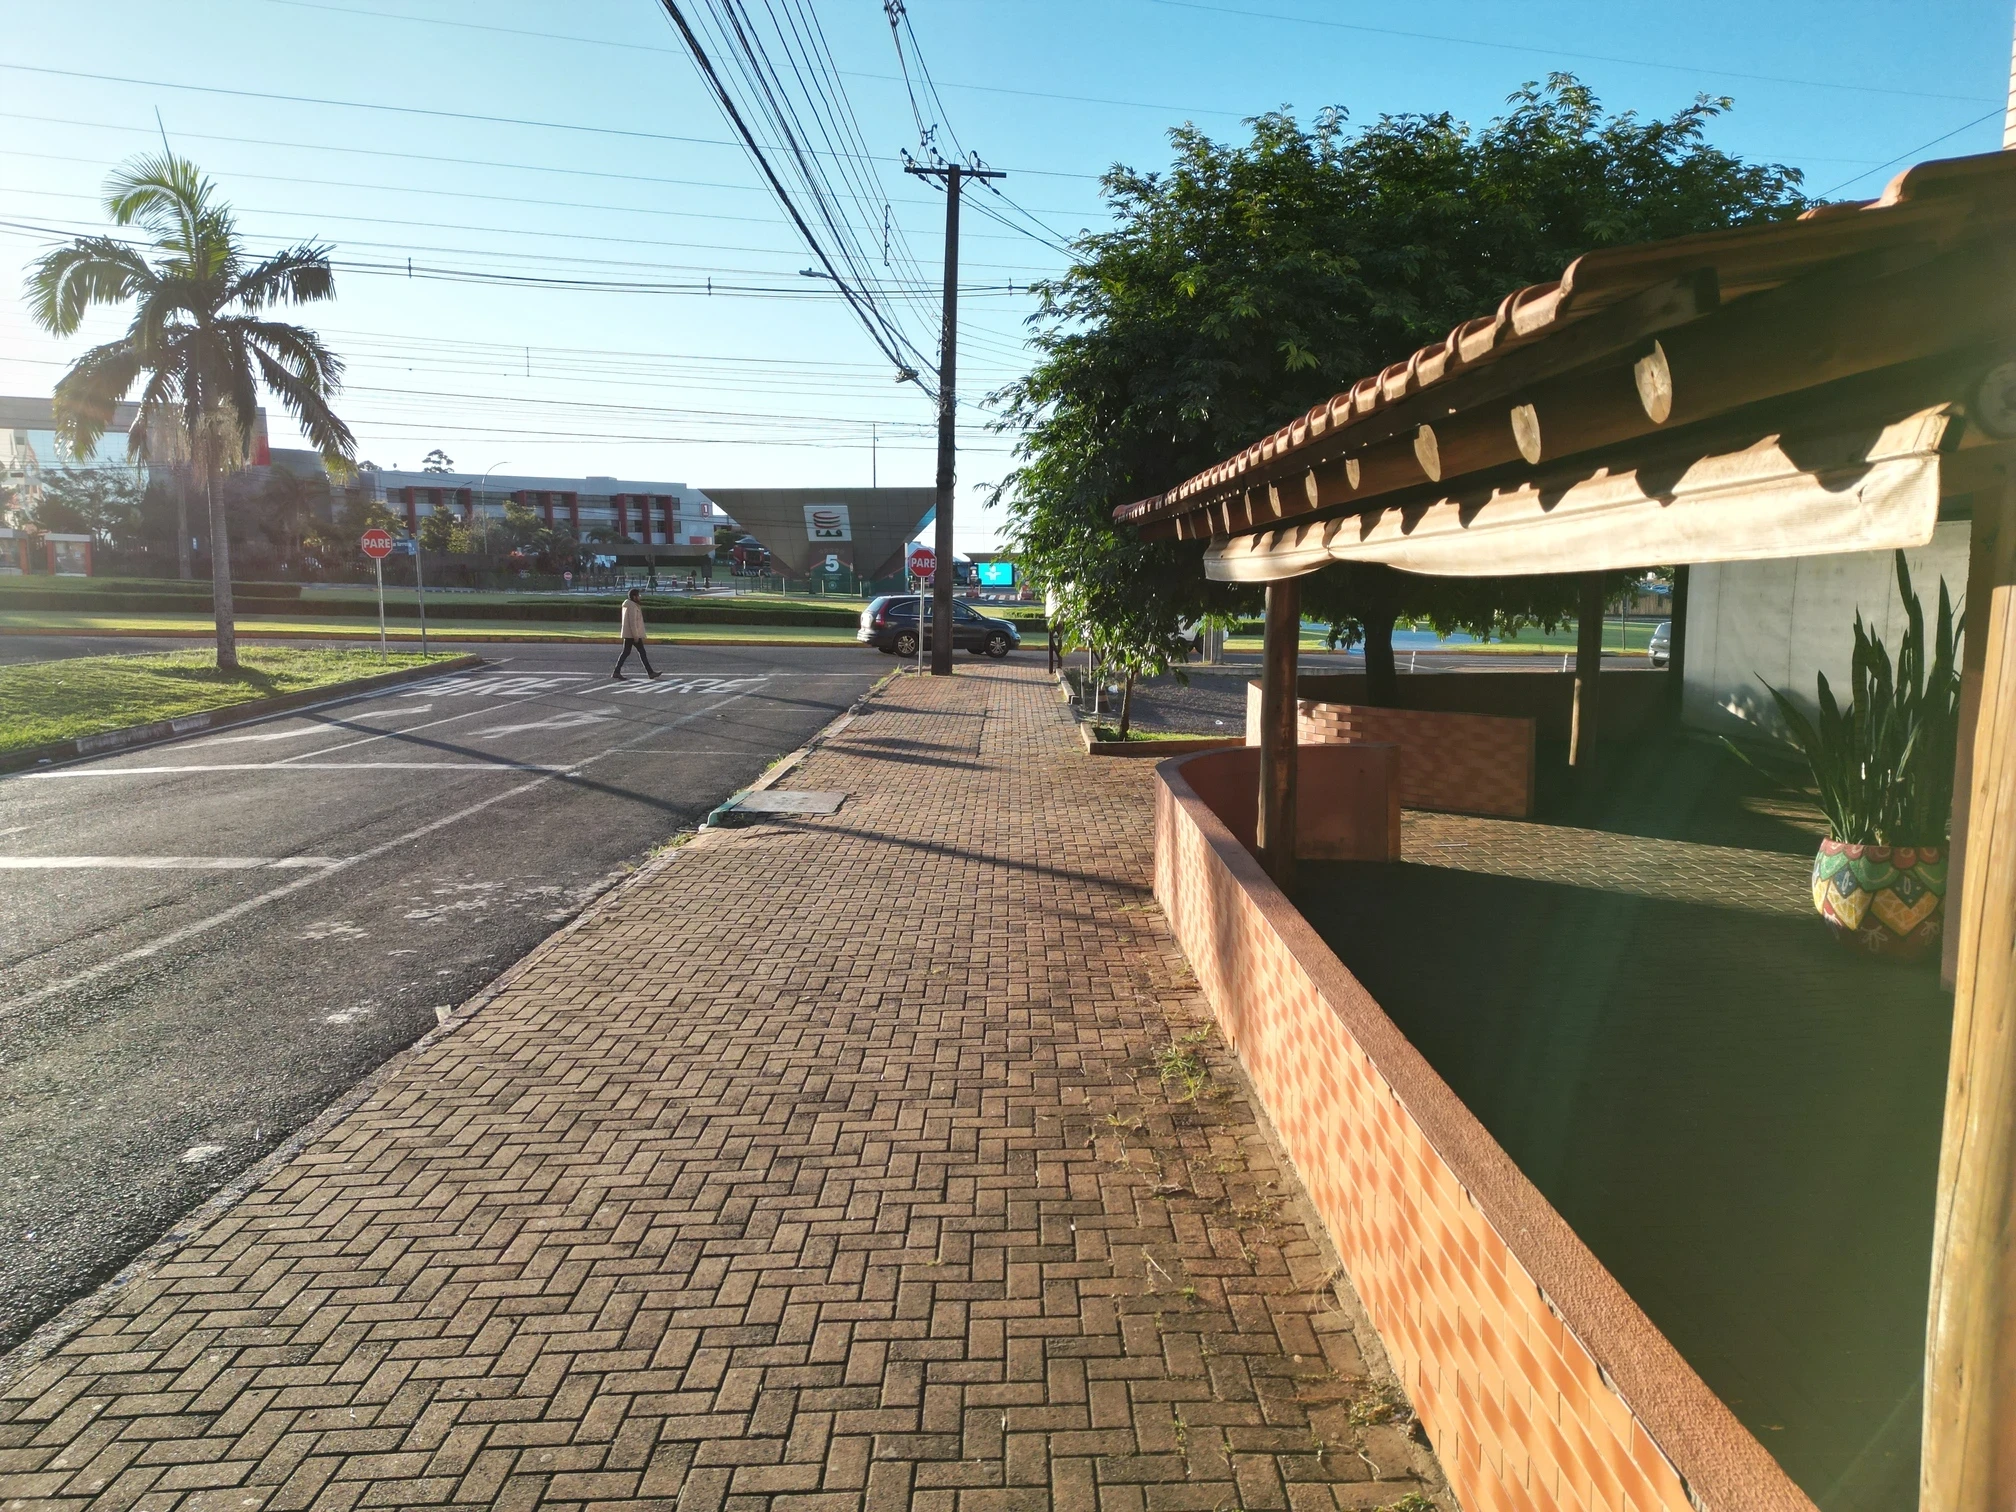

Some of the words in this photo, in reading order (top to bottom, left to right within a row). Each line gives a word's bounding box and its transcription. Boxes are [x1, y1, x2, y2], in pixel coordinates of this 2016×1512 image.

[363, 538, 391, 549] PARE
[825, 554, 840, 572] 5
[911, 557, 936, 569] PARE
[575, 677, 769, 695] PARE
